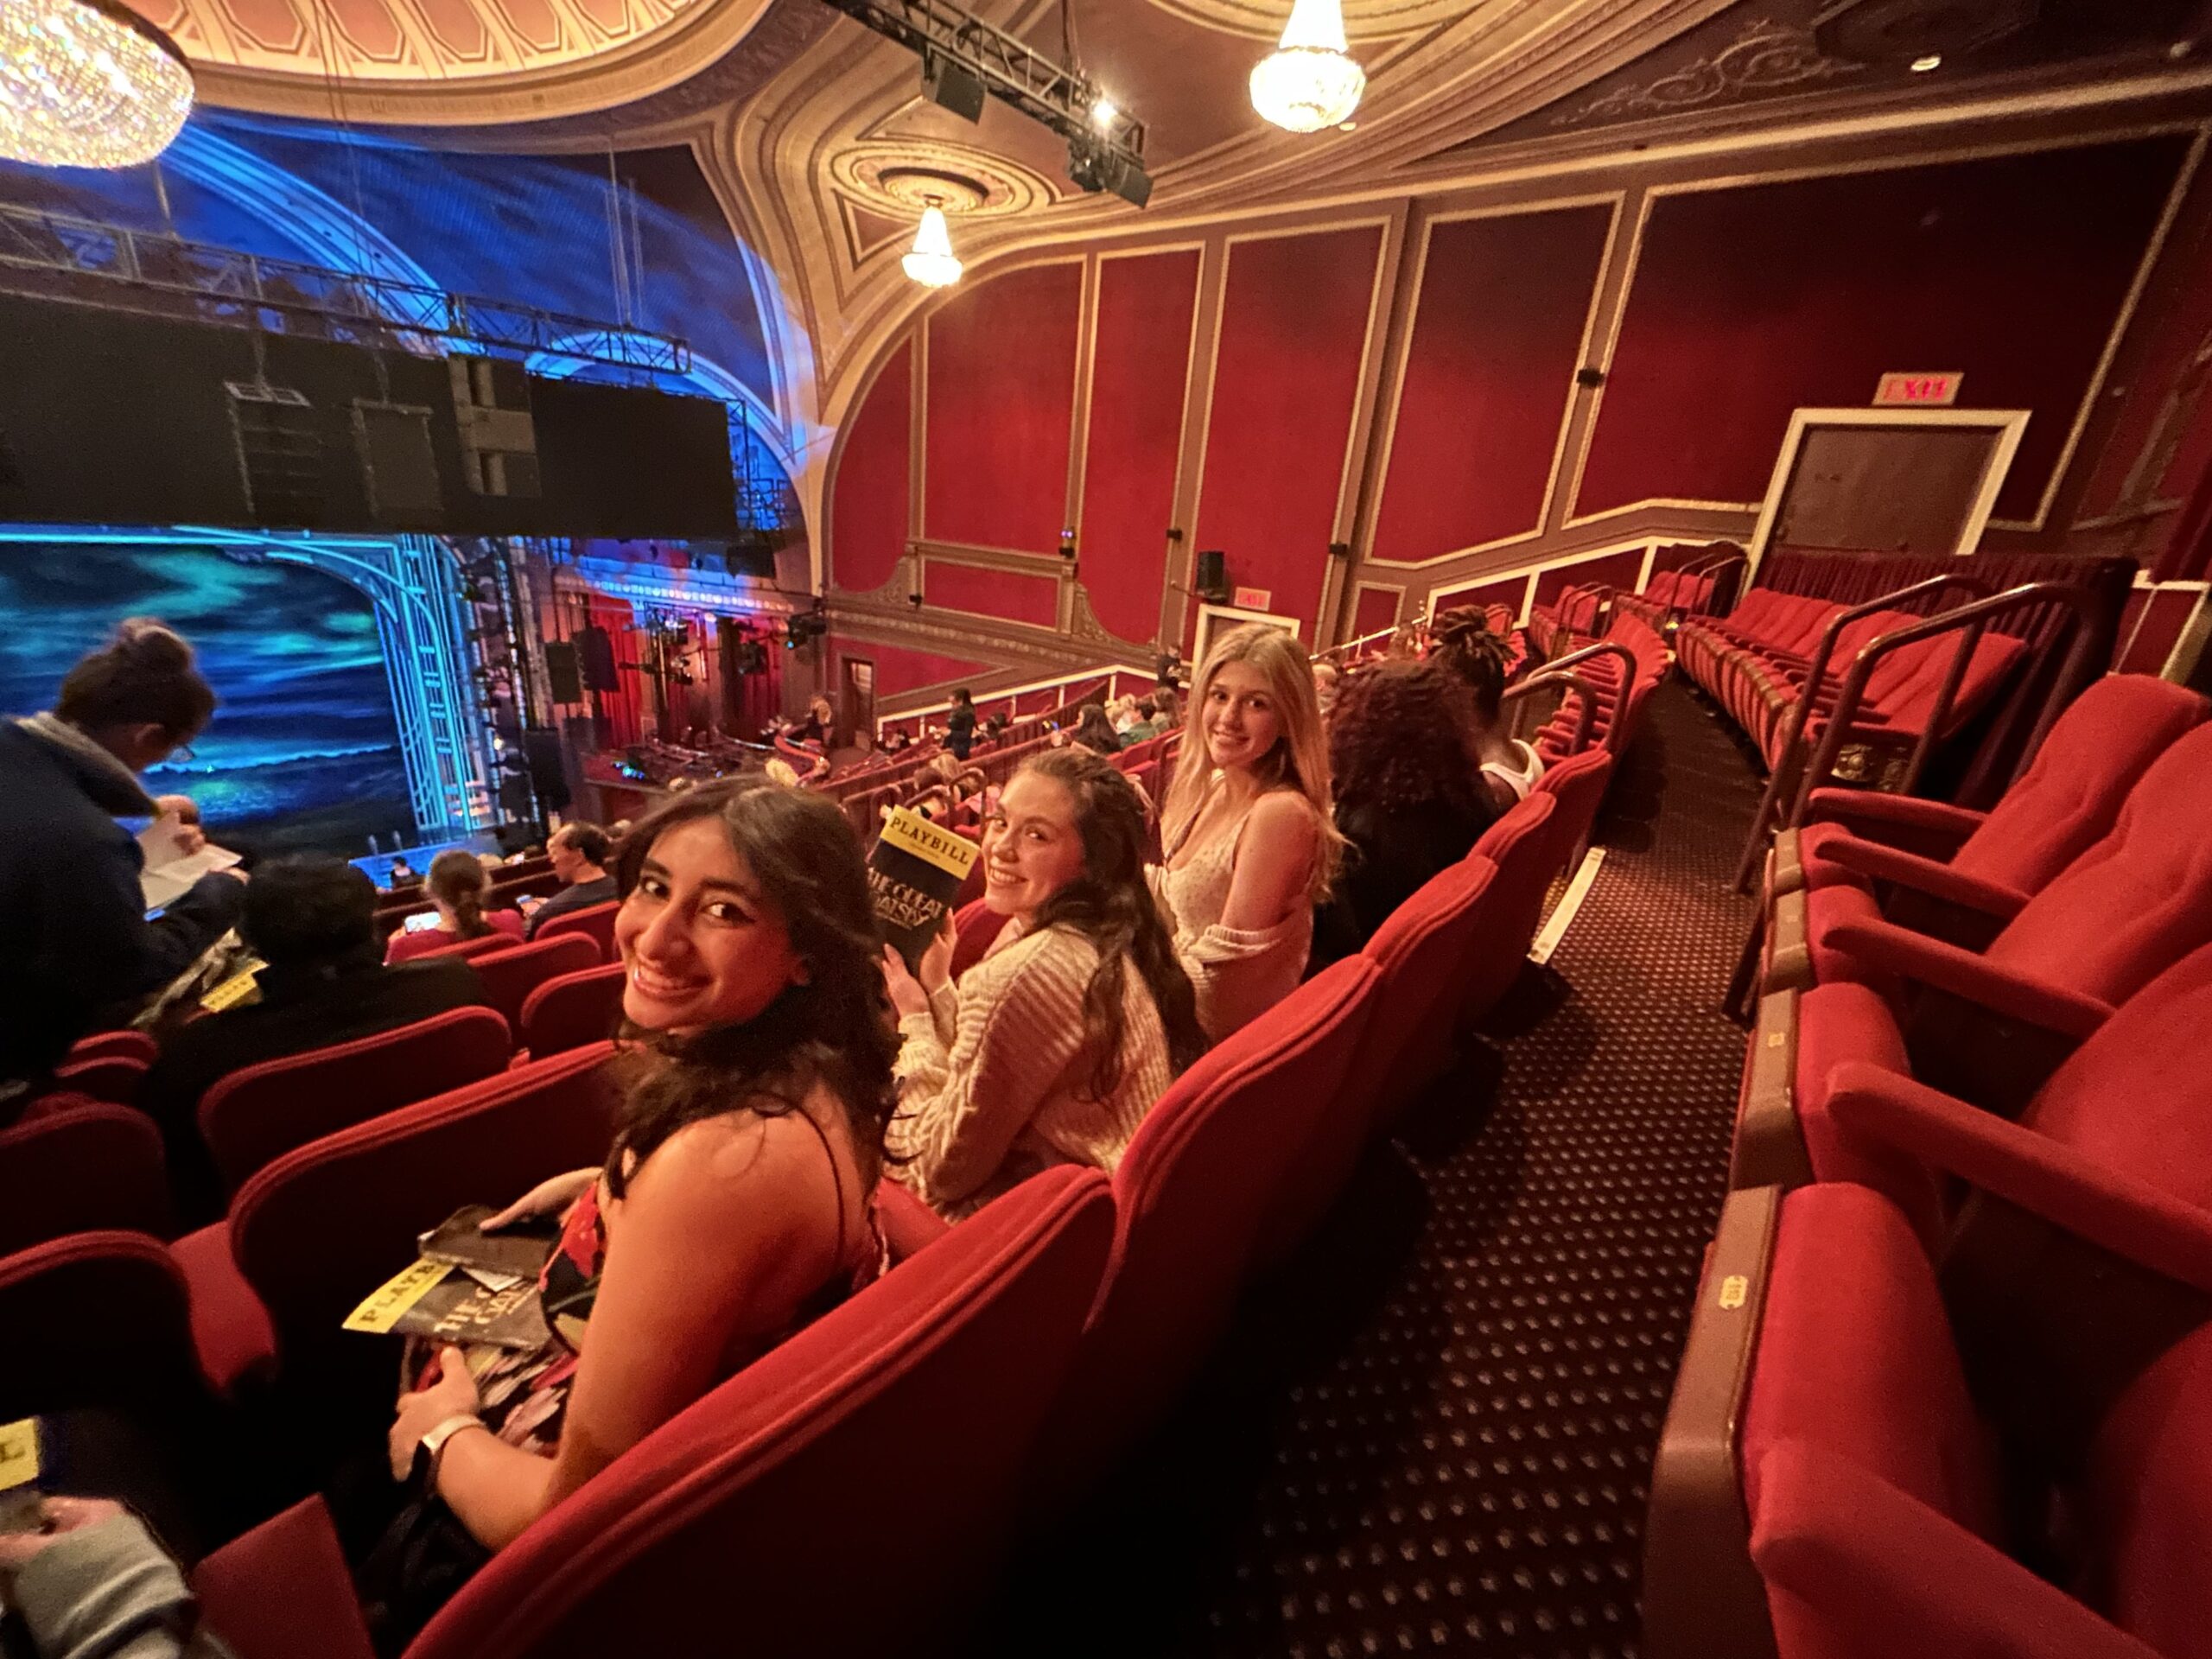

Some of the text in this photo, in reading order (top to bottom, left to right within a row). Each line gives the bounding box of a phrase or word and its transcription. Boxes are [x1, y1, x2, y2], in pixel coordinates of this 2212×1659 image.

[1883, 378, 1948, 401] EXIT
[890, 817, 969, 865] PLAYBILL
[359, 1264, 435, 1323] PLAYB
